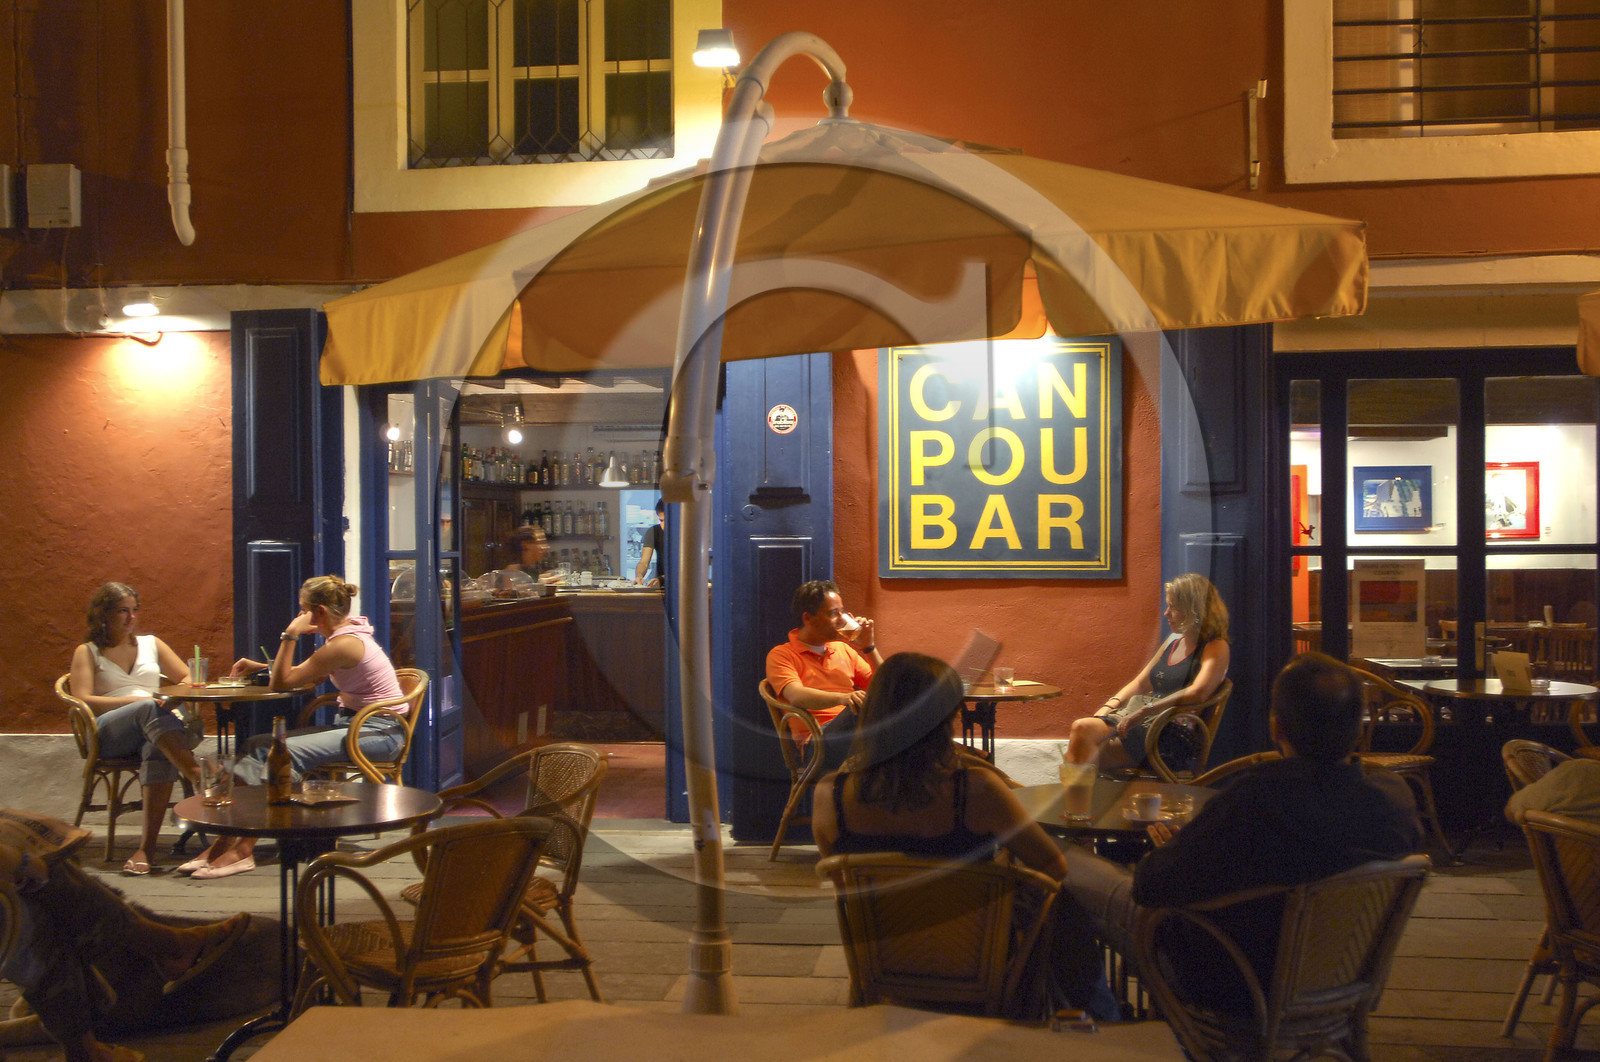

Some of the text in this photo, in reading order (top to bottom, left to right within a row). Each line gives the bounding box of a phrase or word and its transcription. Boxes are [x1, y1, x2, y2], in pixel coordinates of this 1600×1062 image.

[909, 362, 1087, 421] CAN
[909, 427, 1087, 486] POU
[910, 494, 1085, 549] BAR
